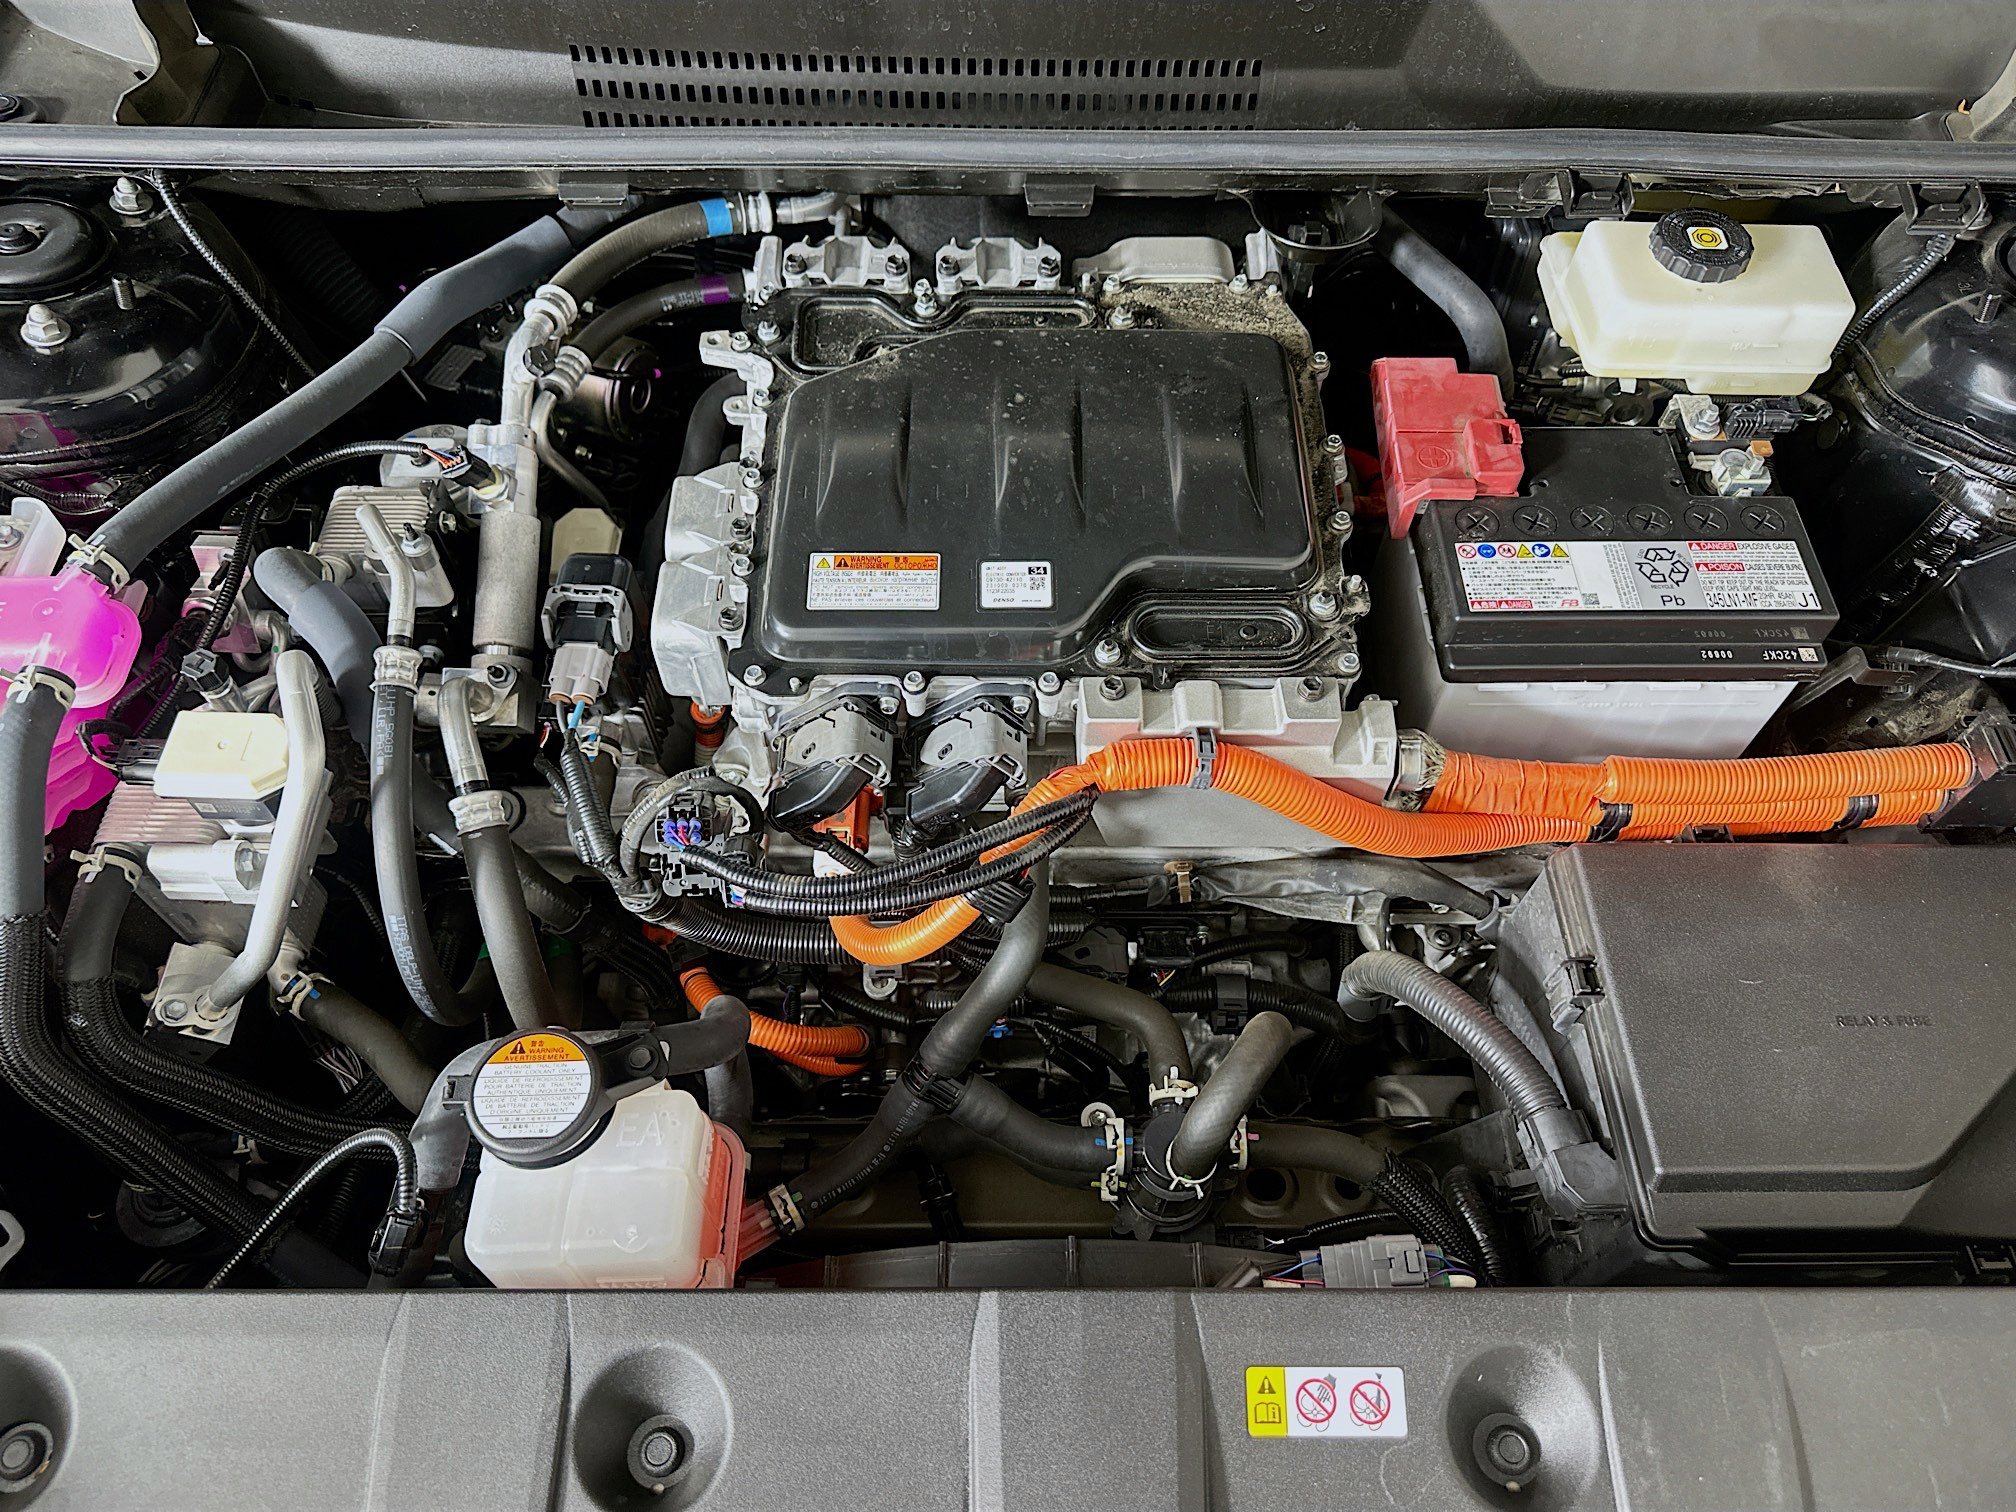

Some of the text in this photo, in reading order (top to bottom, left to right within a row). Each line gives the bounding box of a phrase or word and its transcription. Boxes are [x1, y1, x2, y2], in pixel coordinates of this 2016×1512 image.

[1700, 542, 1795, 551] DANGER EXPLOSIVE GASES
[1030, 567, 1045, 575] 34
[1707, 563, 1804, 571] POISON CAUSES SEVERE BURNS
[1507, 600, 1532, 609] DANGER
[1560, 599, 1580, 607] FB
[1660, 595, 1686, 607] Pb
[1705, 592, 1758, 608] 345LN1-MF
[1798, 592, 1819, 608] J1
[1762, 649, 1798, 660] 42CKF
[1835, 1015, 1932, 1027] RELAY & FUSE
[504, 1053, 570, 1062] AVERTISSEMENT
